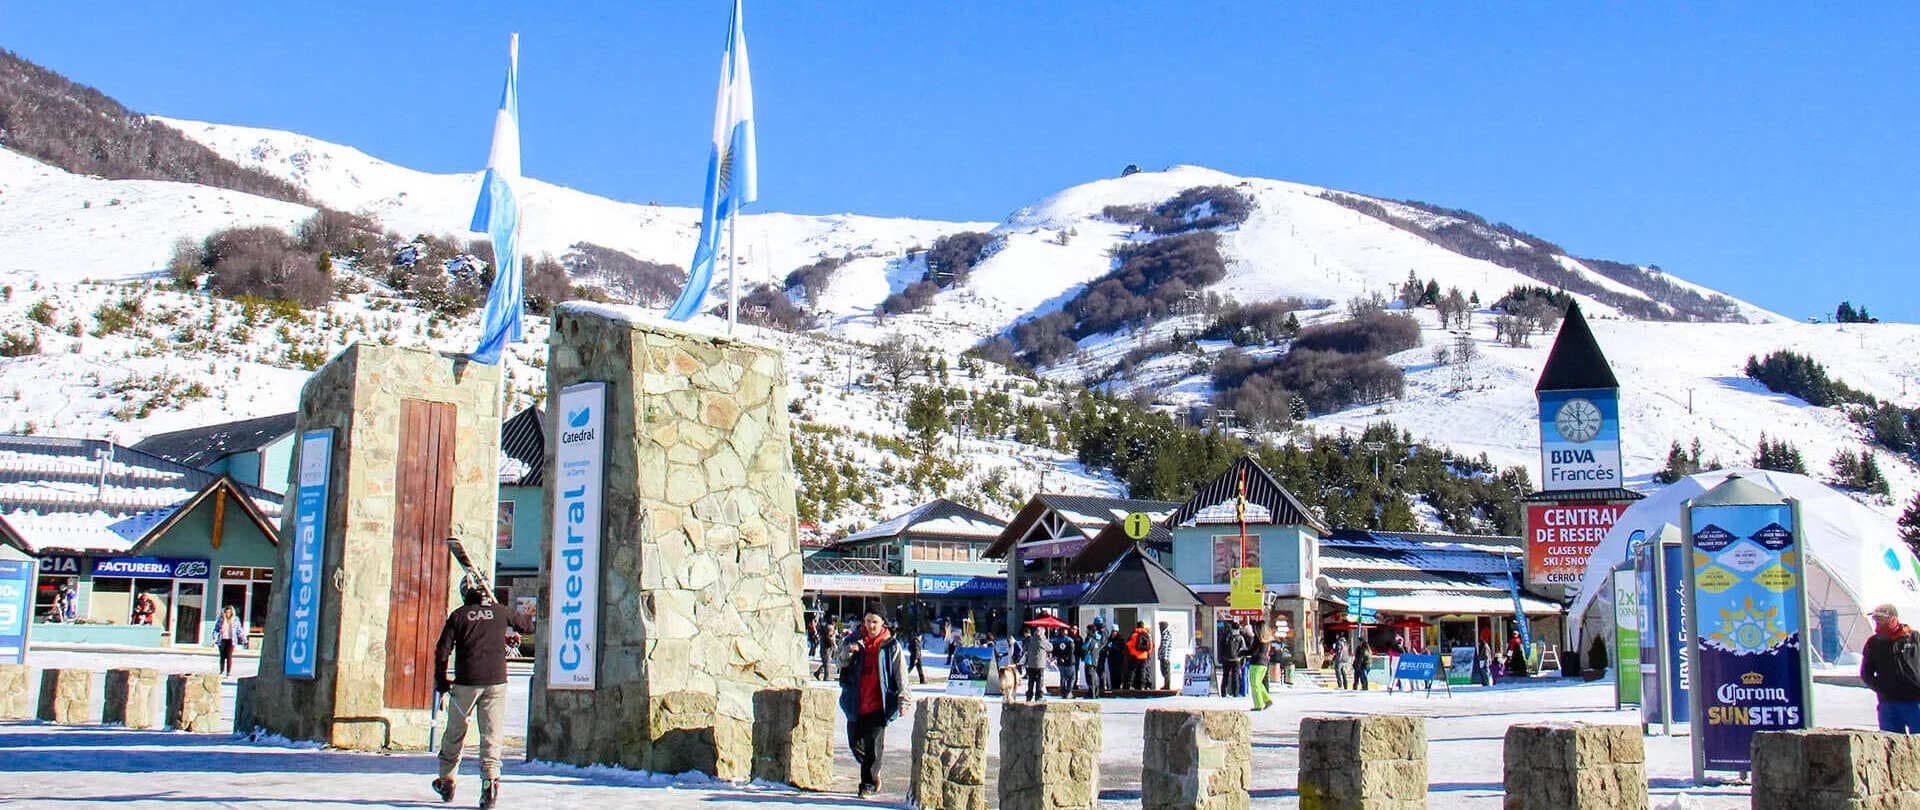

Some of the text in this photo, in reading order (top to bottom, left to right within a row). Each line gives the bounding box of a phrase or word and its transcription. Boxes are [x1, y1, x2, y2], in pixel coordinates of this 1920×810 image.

[562, 427, 594, 444] Catedral
[1551, 449, 1595, 464] BBVA
[1551, 464, 1614, 481] Francés
[1536, 528, 1556, 543] DE
[1548, 546, 1576, 555] CLASES
[98, 561, 171, 573] FACTURERIA
[1543, 556, 1558, 566] SKI
[559, 484, 586, 671] Catedral
[1547, 573, 1575, 582] CERRO
[290, 511, 316, 665] Catedral
[467, 610, 494, 621] CAB
[1717, 683, 1789, 706] Corona
[1708, 705, 1800, 726] SUNSETS
